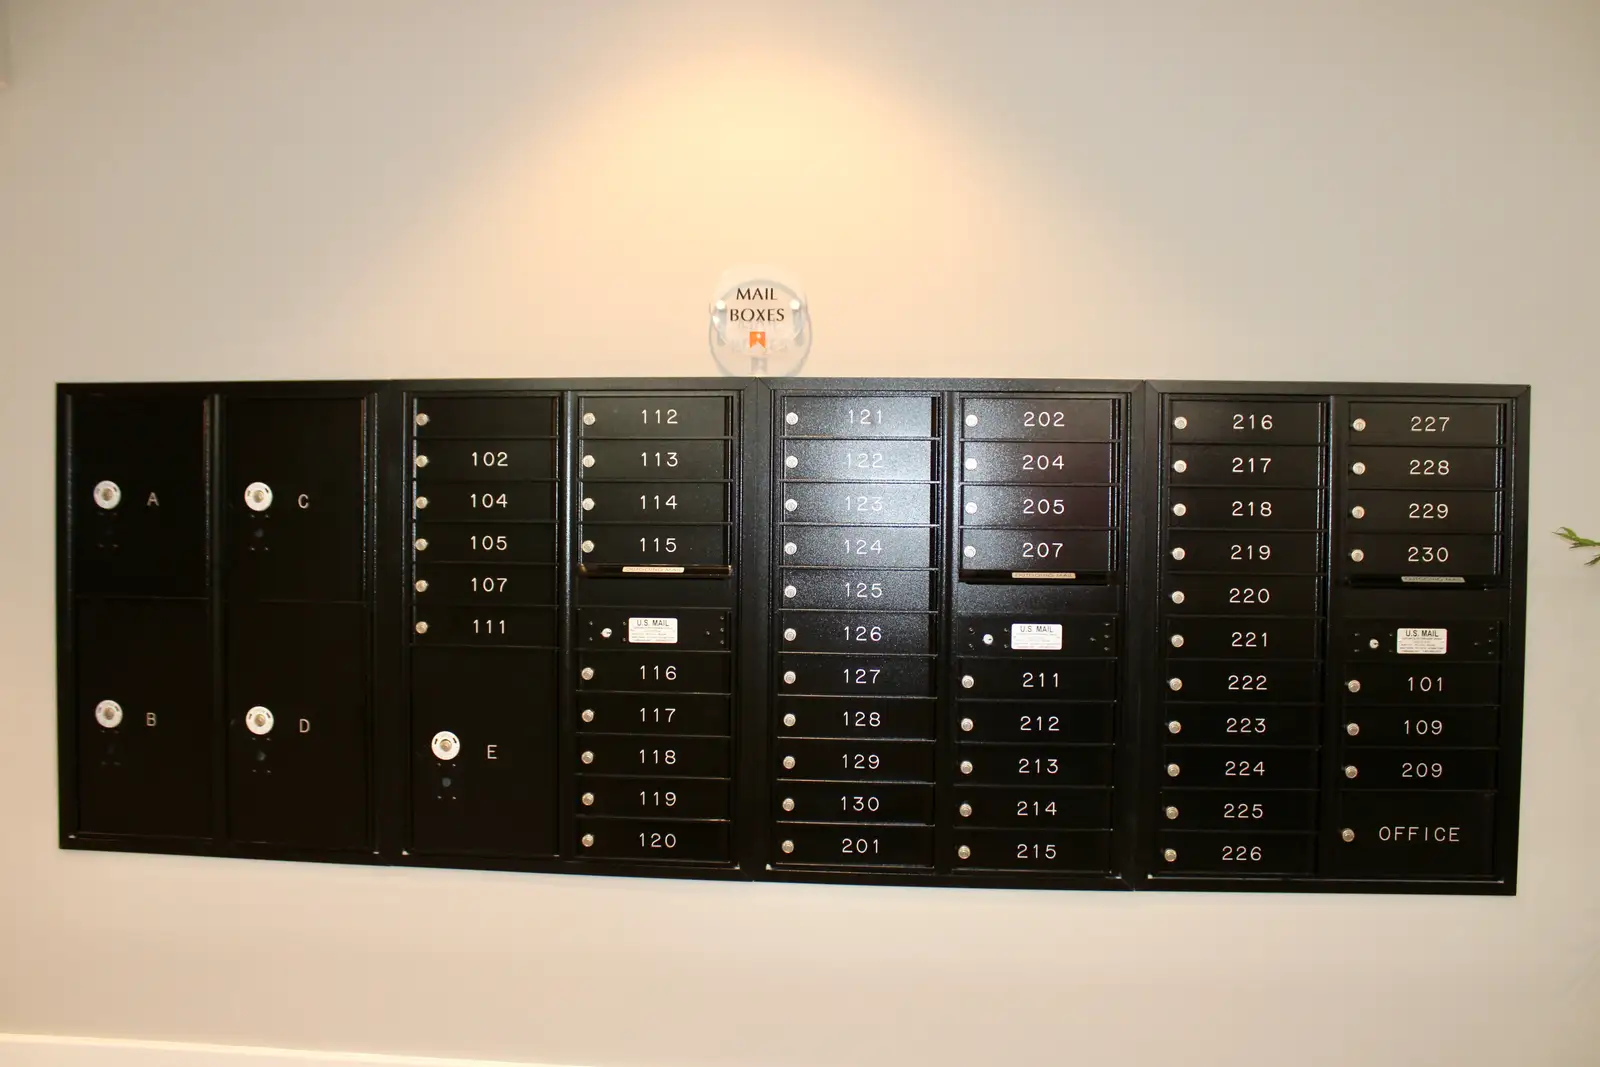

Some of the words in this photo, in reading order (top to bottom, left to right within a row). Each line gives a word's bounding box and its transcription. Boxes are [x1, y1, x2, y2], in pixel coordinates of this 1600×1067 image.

[736, 287, 777, 300] MAIL
[730, 308, 785, 322] BOXES
[641, 408, 678, 425] 112
[846, 409, 883, 425] 121
[1023, 411, 1065, 427] 202
[1232, 413, 1273, 430] 216
[1410, 415, 1450, 432] 227
[471, 451, 509, 467] 102
[641, 451, 679, 468] 113
[846, 452, 883, 468] 122
[1022, 454, 1065, 471] 204
[1232, 456, 1272, 473] 217
[1409, 459, 1450, 476] 228
[146, 491, 160, 506] A
[297, 493, 309, 509] C
[470, 493, 508, 509] 104
[640, 494, 678, 510] 114
[845, 496, 883, 512] 123
[1022, 498, 1065, 515] 205
[1231, 500, 1272, 517] 218
[1408, 502, 1449, 519] 229
[470, 535, 508, 551] 105
[639, 537, 677, 553] 115
[844, 539, 882, 554] 124
[1022, 542, 1064, 558] 207
[1230, 544, 1271, 561] 219
[1407, 546, 1449, 563] 230
[471, 577, 508, 593] 107
[844, 583, 882, 598] 125
[1229, 587, 1270, 604] 220
[473, 619, 505, 635] 111
[636, 619, 650, 627] U.S.
[652, 619, 670, 627] MAIL
[1036, 625, 1054, 633] MAIL
[843, 625, 882, 642] 126
[1231, 631, 1267, 648] 221
[1405, 629, 1420, 637] U.S.
[1421, 629, 1439, 637] MAIL
[640, 664, 677, 681] 116
[843, 668, 881, 684] 127
[1022, 672, 1059, 688] 211
[1228, 674, 1268, 691] 222
[1407, 676, 1442, 692] 101
[146, 712, 157, 727] B
[640, 707, 676, 723] 117
[843, 711, 881, 727] 128
[299, 718, 311, 733] D
[1020, 715, 1060, 732] 212
[1226, 717, 1266, 734] 223
[1404, 719, 1443, 736] 109
[487, 744, 498, 760] E
[639, 749, 677, 765] 118
[842, 753, 880, 770] 129
[1018, 758, 1059, 774] 213
[1224, 760, 1266, 776] 224
[1401, 762, 1443, 778] 209
[639, 790, 677, 807] 119
[840, 795, 880, 812] 130
[1017, 800, 1057, 816] 214
[1223, 803, 1264, 819] 225
[639, 832, 677, 849] 120
[1378, 825, 1460, 842] OFFICE
[841, 837, 879, 854] 201
[1016, 843, 1057, 860] 215
[1222, 845, 1262, 862] 226
